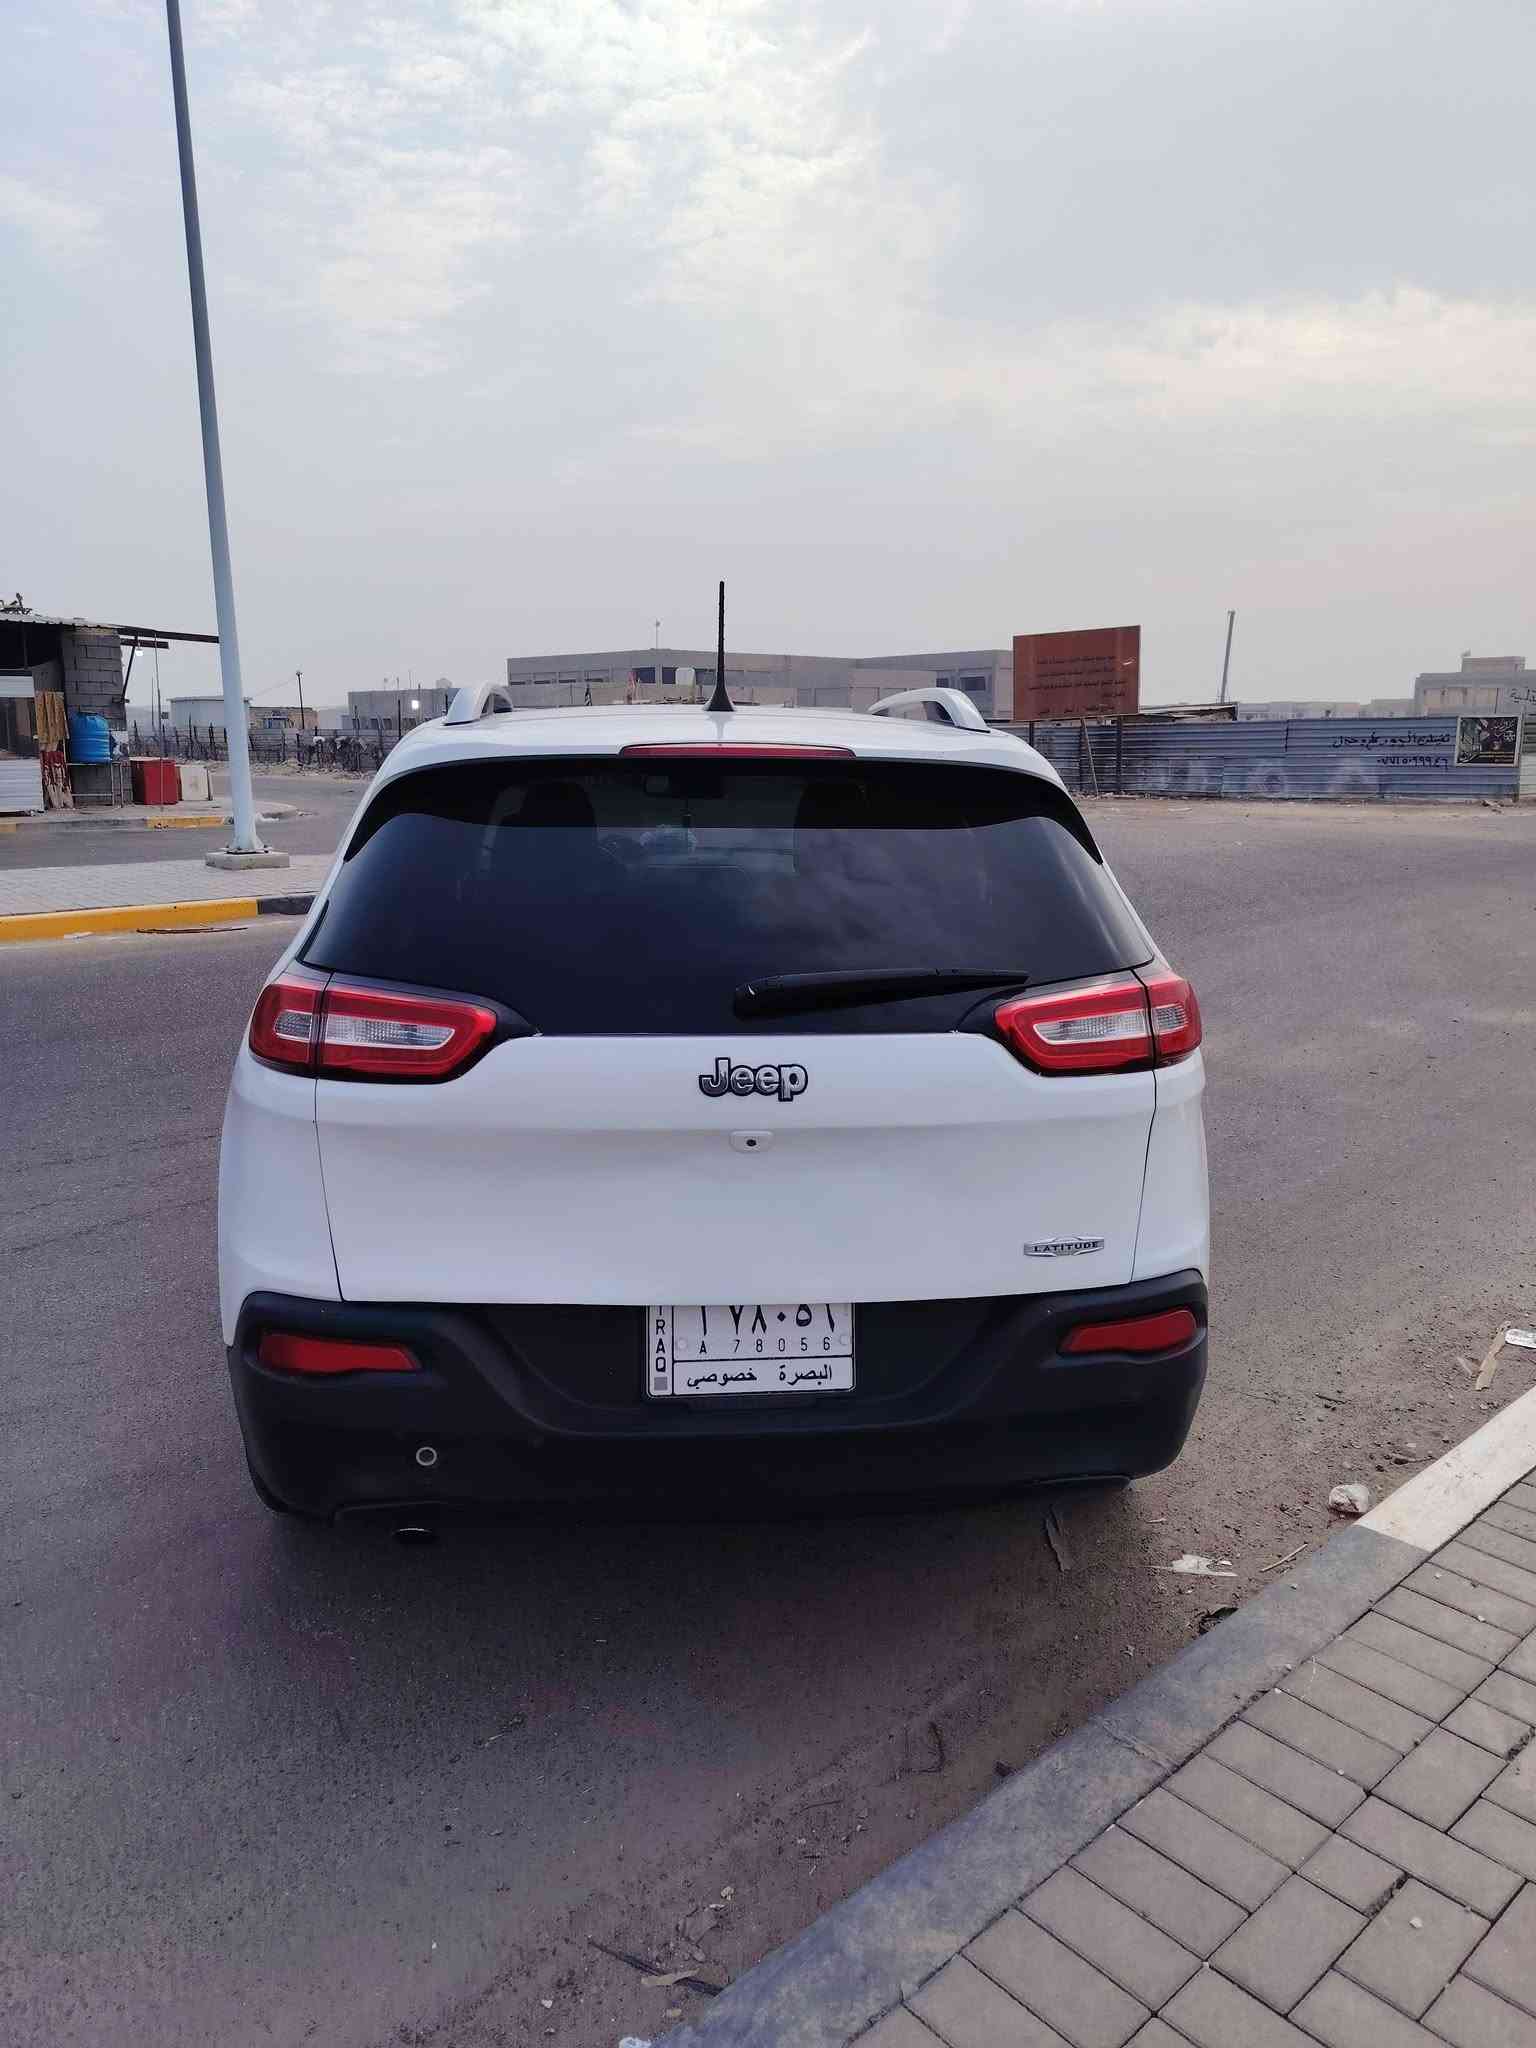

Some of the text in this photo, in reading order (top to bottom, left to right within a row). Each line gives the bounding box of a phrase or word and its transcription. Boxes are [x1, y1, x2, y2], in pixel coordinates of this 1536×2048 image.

[698, 1057, 808, 1102] Jeep
[1033, 1240, 1099, 1252] LATITUDE
[687, 1363, 832, 1389] البصرة خصوصي
